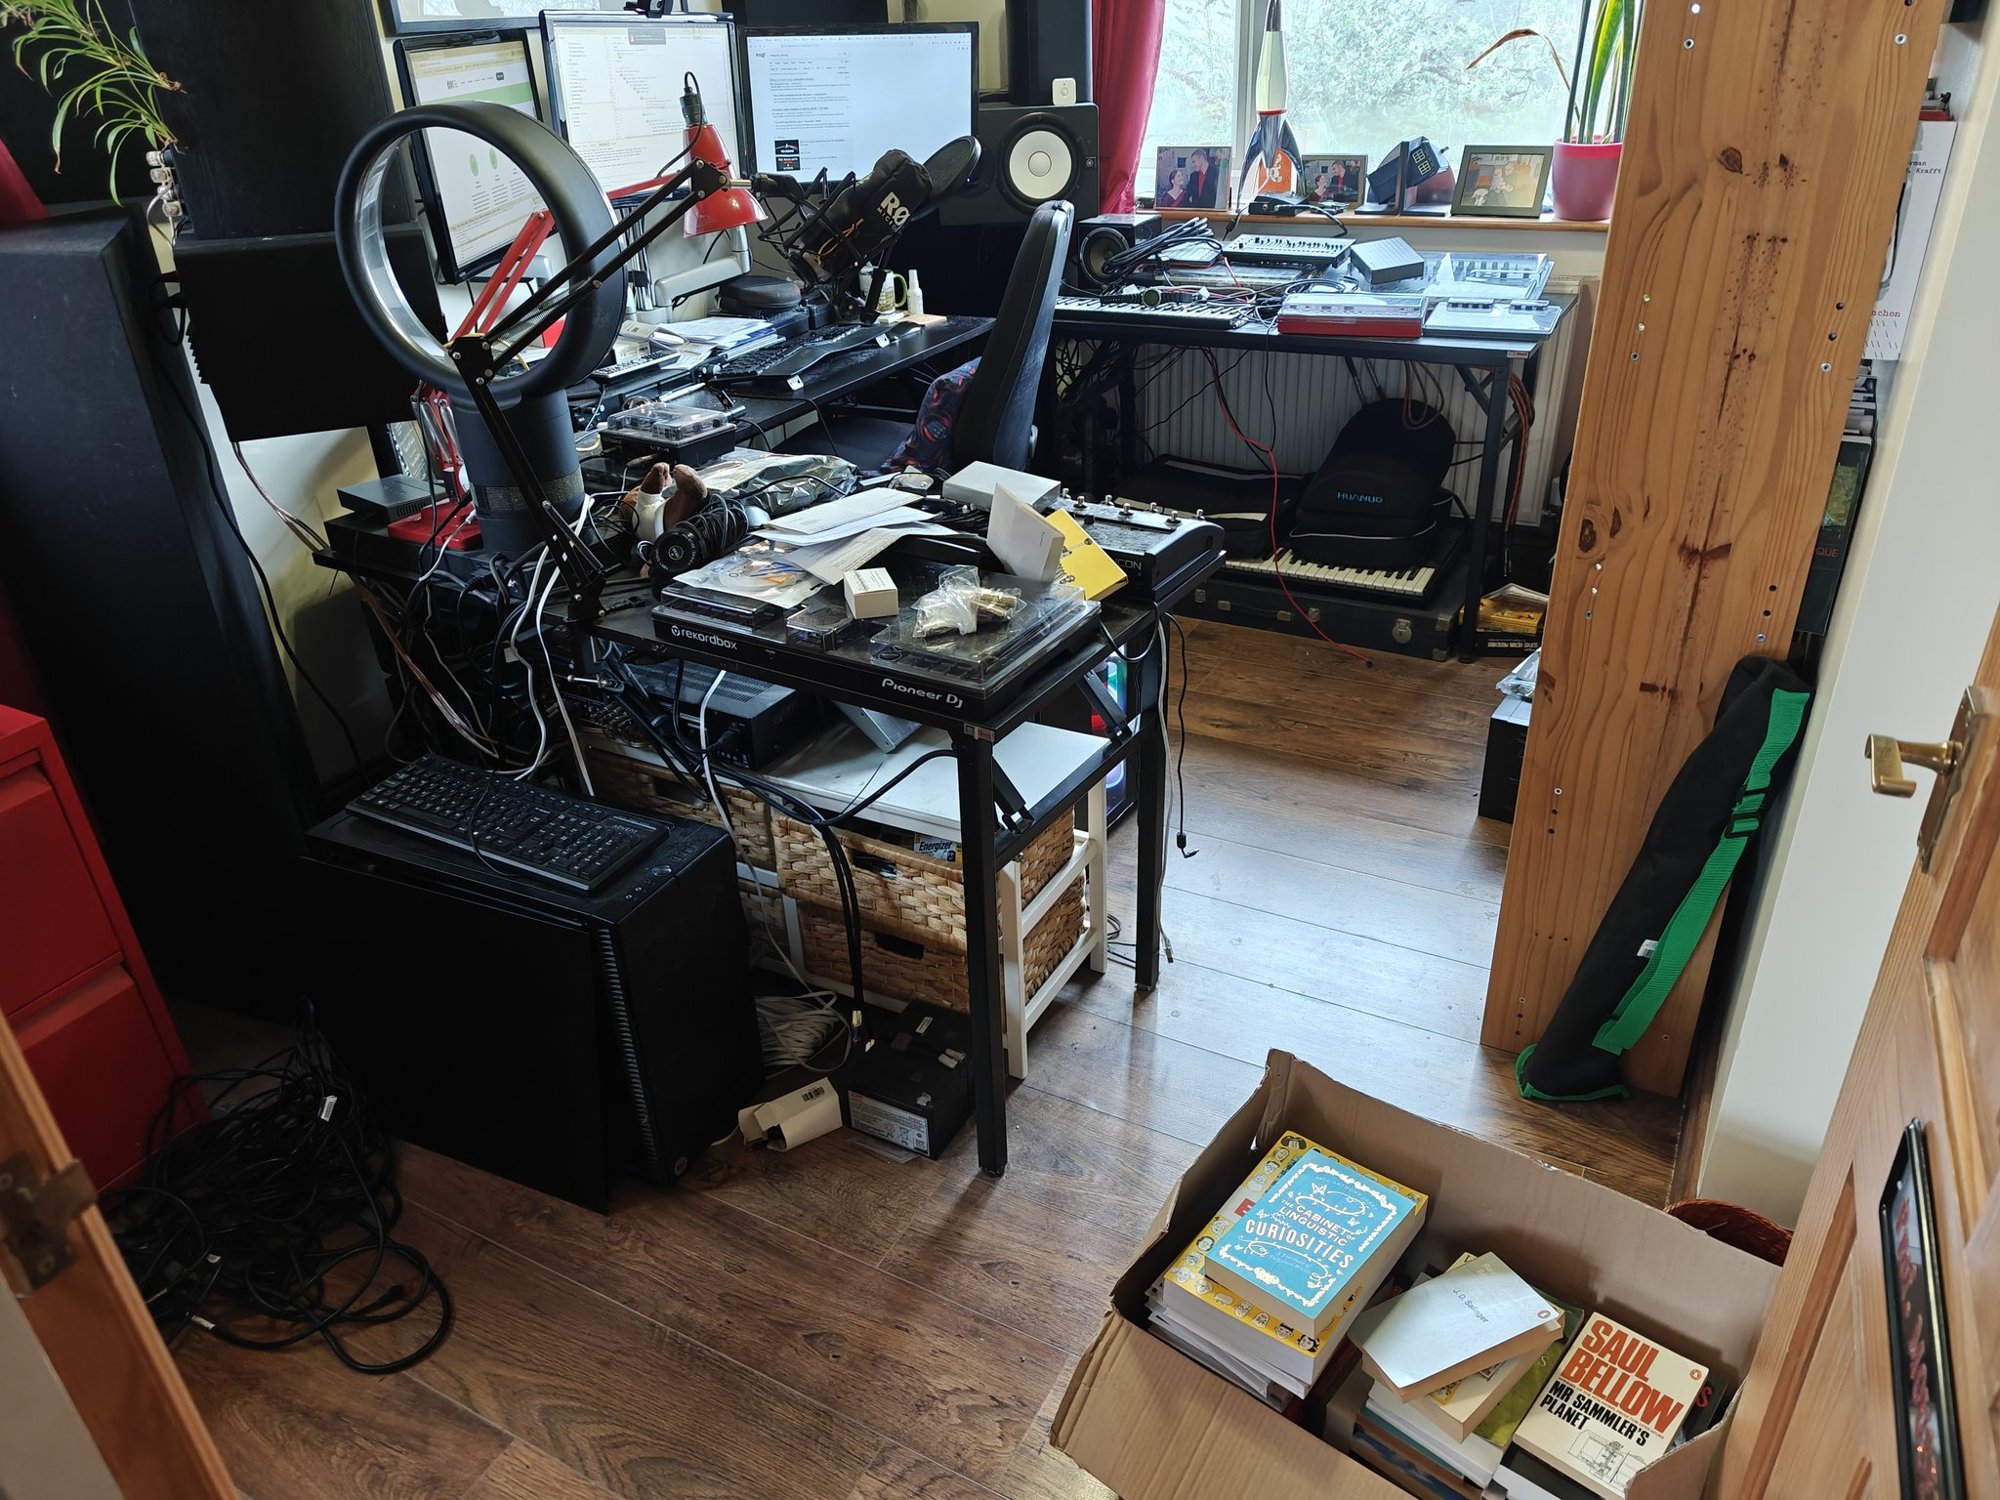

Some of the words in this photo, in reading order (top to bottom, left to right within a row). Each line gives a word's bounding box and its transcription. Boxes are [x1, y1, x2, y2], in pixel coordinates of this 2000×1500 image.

[1915, 167, 1942, 175] Krafft
[880, 191, 911, 227] RØ
[1871, 309, 1901, 318] nchon
[1816, 546, 1839, 558] QUE
[681, 628, 738, 650] rekordbox
[881, 678, 943, 701] Pioneer
[919, 841, 953, 853] Energizer
[1234, 1197, 1256, 1217] E
[1281, 1199, 1295, 1209] THE
[1296, 1205, 1351, 1237] CABINET
[1279, 1206, 1348, 1247] LINGUISTIC
[1245, 1219, 1354, 1269] CURIOSITIES
[1538, 1353, 1550, 1367] S
[1581, 1319, 1660, 1383] SAUL
[1560, 1347, 1685, 1434] BELLOW
[1695, 1385, 1713, 1408] S
[1539, 1393, 1591, 1431] PLANET
[1549, 1380, 1574, 1403] MR
[1572, 1393, 1650, 1447] SAMMLER'S
